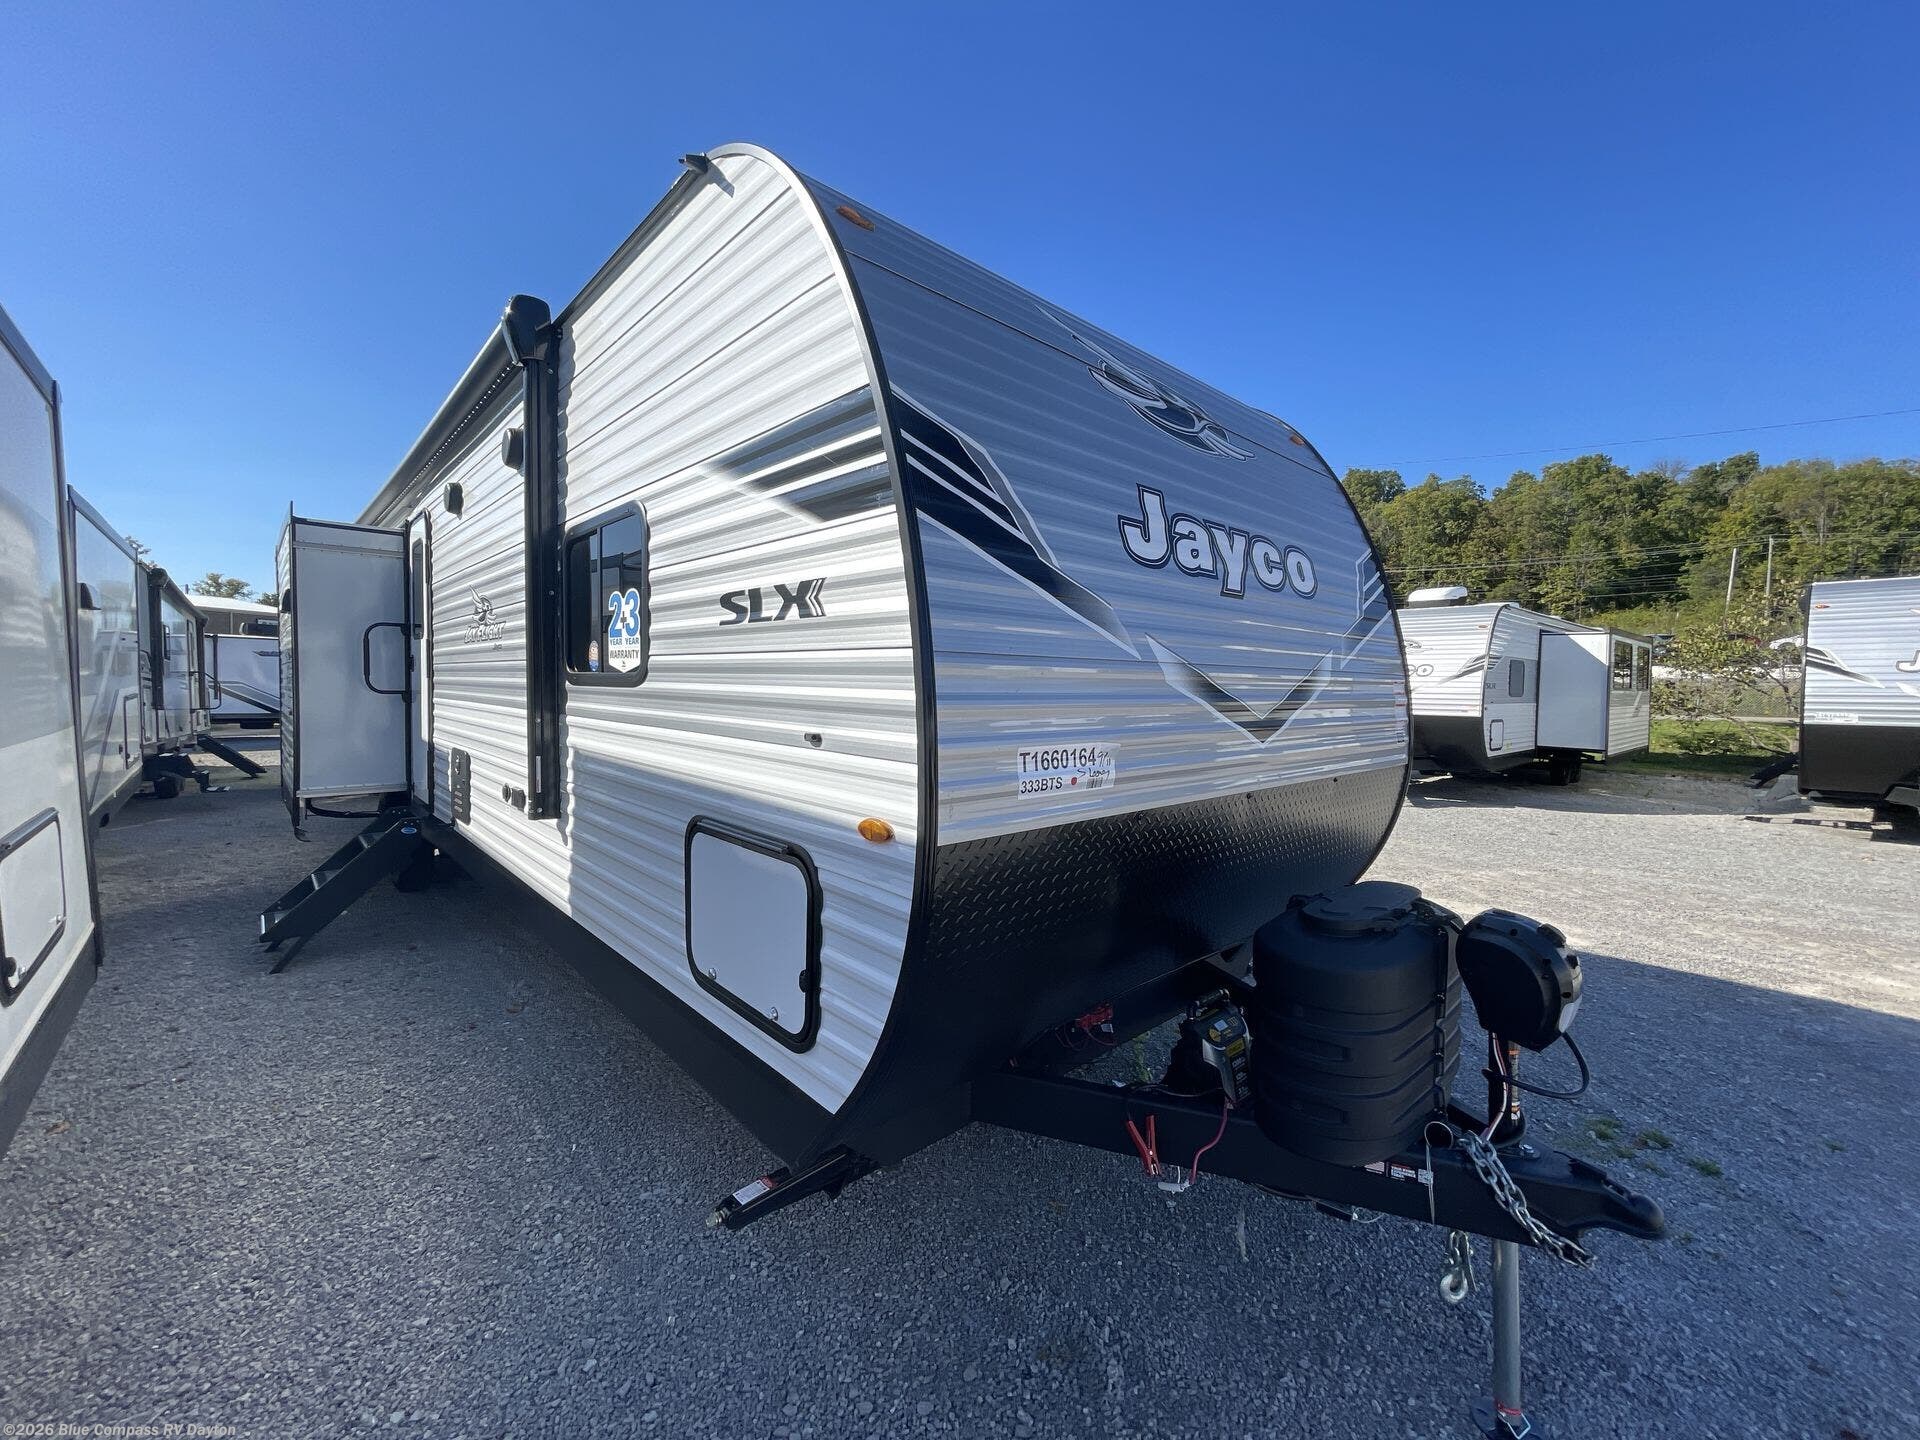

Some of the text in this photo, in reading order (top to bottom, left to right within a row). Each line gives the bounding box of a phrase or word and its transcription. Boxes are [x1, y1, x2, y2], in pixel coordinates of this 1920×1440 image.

[1118, 483, 1318, 600] Jayco
[719, 577, 827, 626] SLX
[610, 637, 640, 646] YEAR YEAR
[610, 649, 640, 659] WARRANTY
[1019, 747, 1096, 773] T1660164
[1020, 777, 1063, 794] 333BTS
